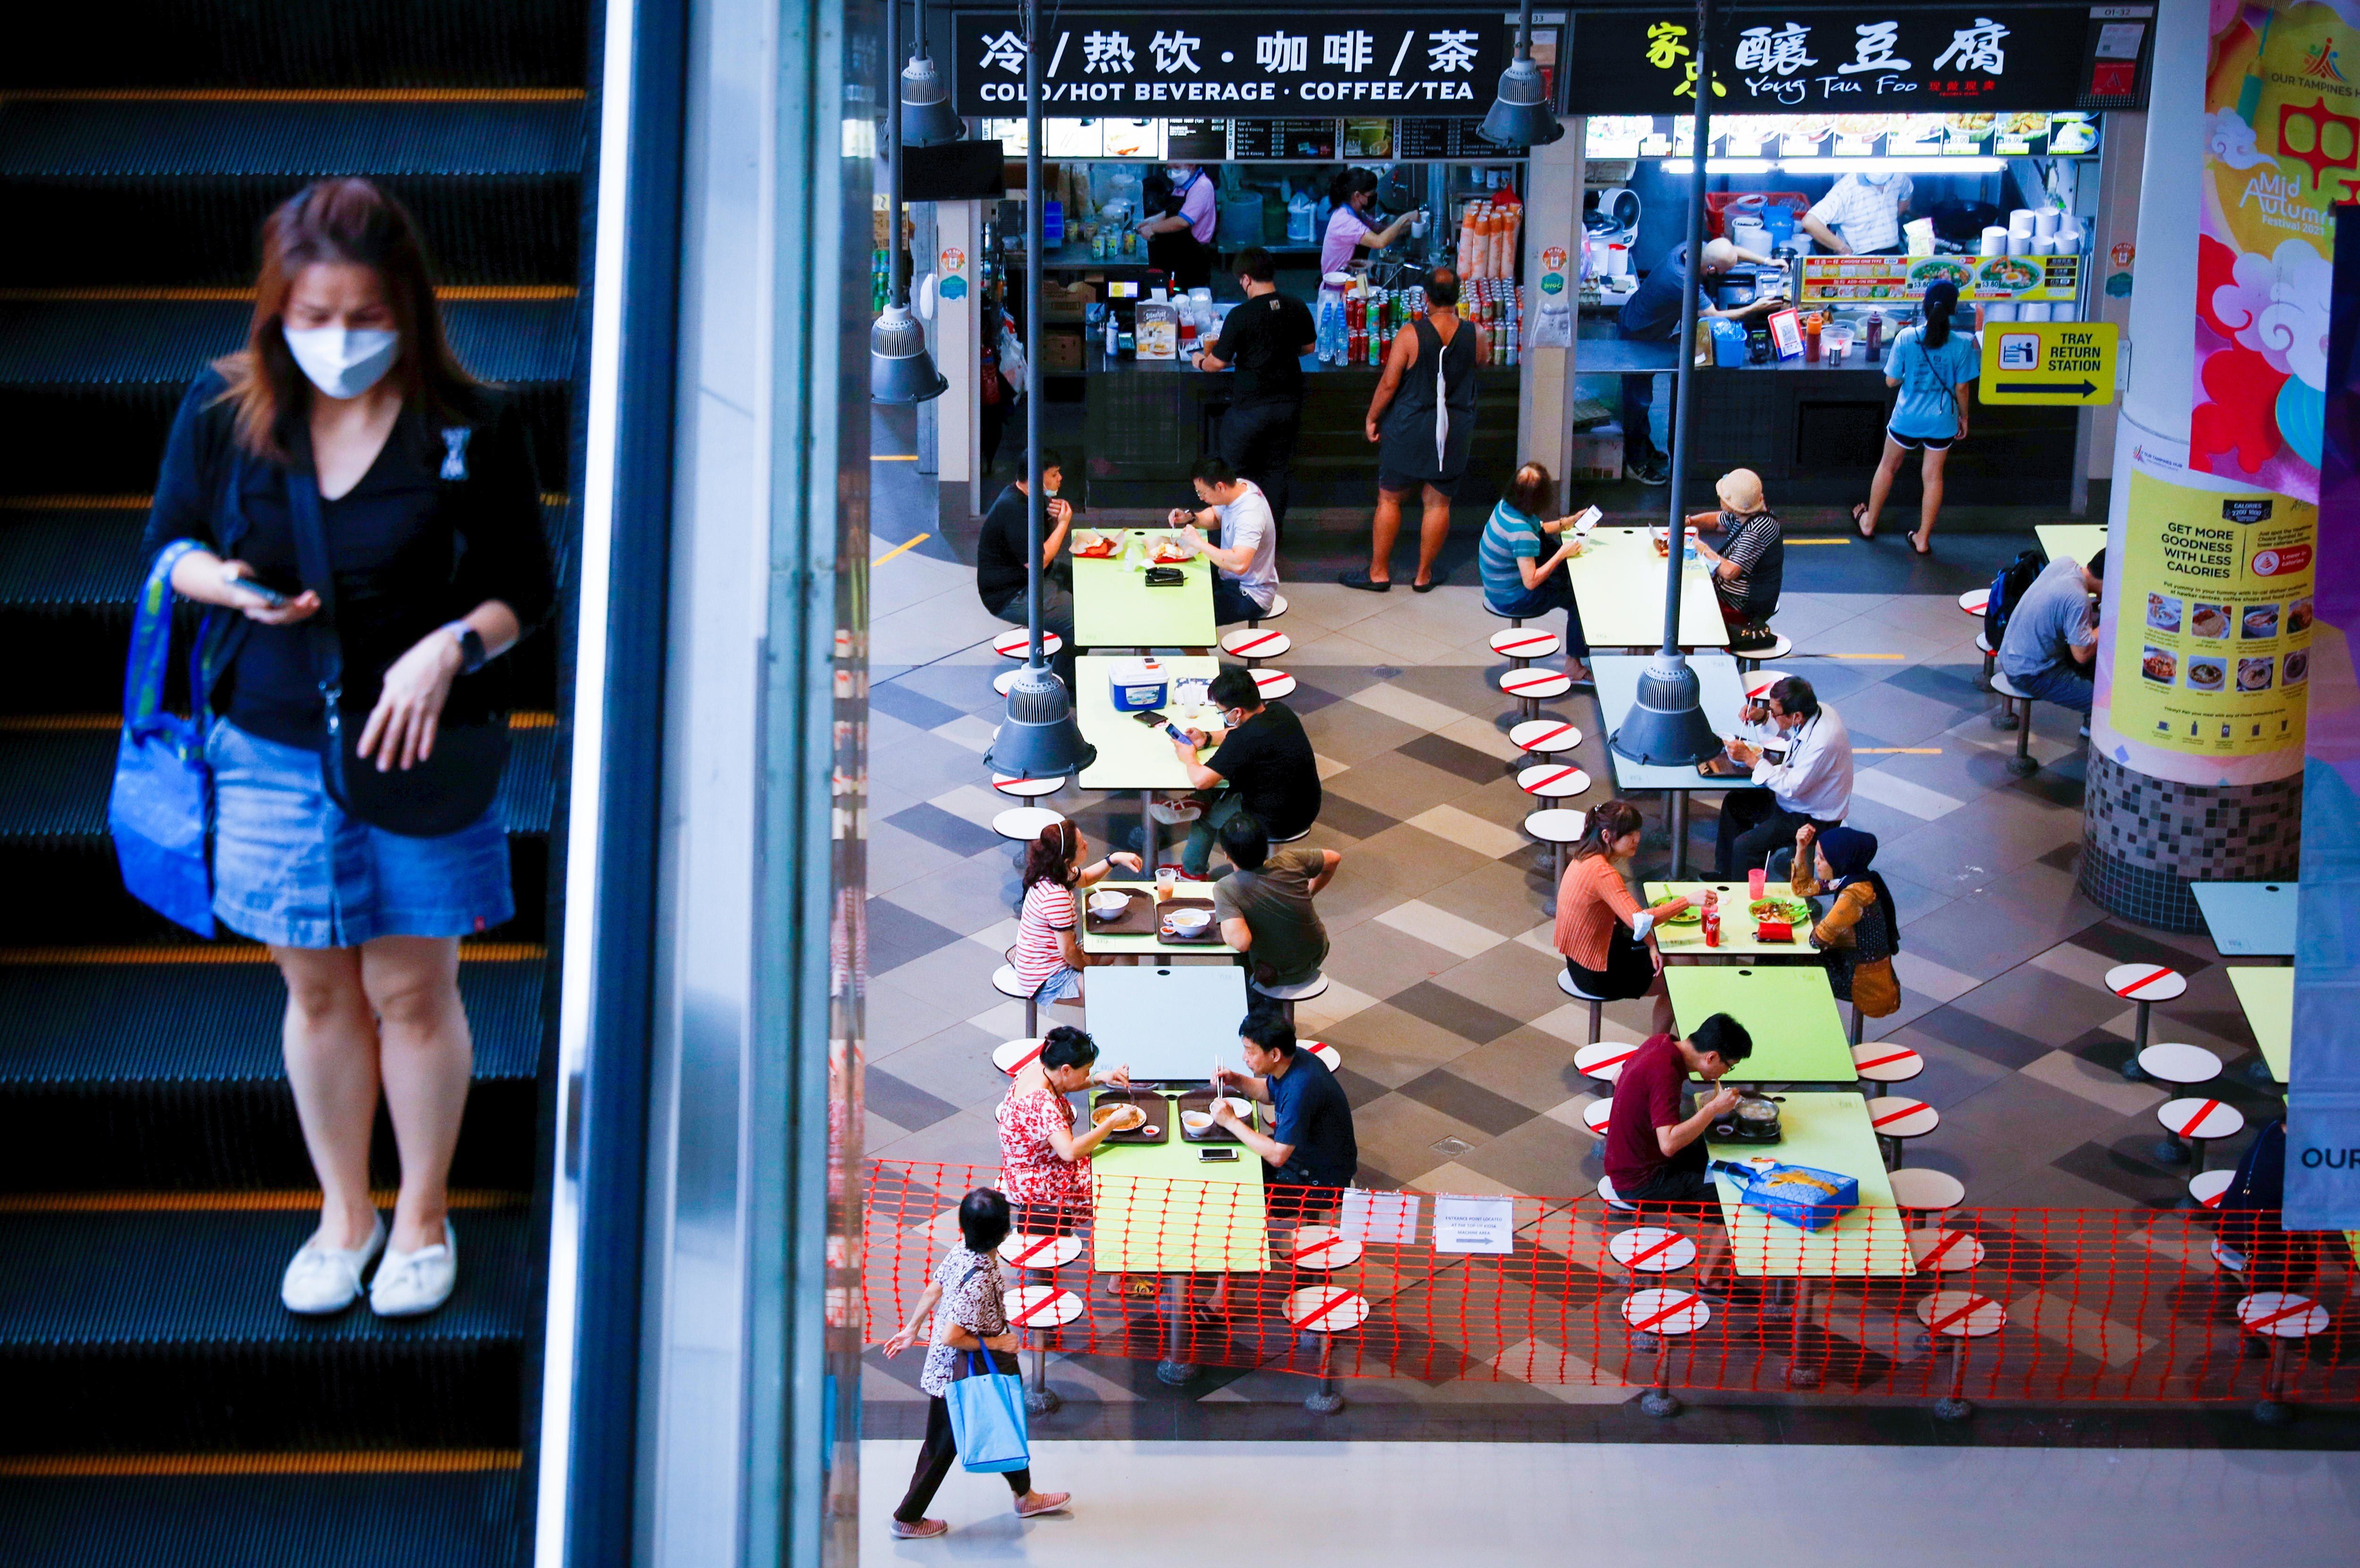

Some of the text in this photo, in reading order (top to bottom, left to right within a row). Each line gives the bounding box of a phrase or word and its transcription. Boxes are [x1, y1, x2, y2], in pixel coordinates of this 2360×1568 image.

[1135, 82, 1275, 101] BEVERAGE
[1300, 81, 1474, 100] COFFEE/TEA
[1745, 75, 1918, 105] Yong Tau Foo
[2271, 74, 2295, 86] OUR
[2298, 77, 2352, 98] TAMPINES
[2259, 172, 2301, 197] Mid
[2262, 214, 2325, 236] Festival 2021
[2061, 333, 2093, 345] TRAY
[2050, 347, 2101, 358] RETURN
[2048, 360, 2101, 371] STATION
[2168, 522, 2234, 540] GET MORE
[2161, 533, 2233, 553] GOODNESS
[2165, 546, 2232, 566] WITH LESS
[2282, 558, 2304, 566] calories
[2167, 561, 2230, 579] CALORIES
[2174, 583, 2194, 592] yummy
